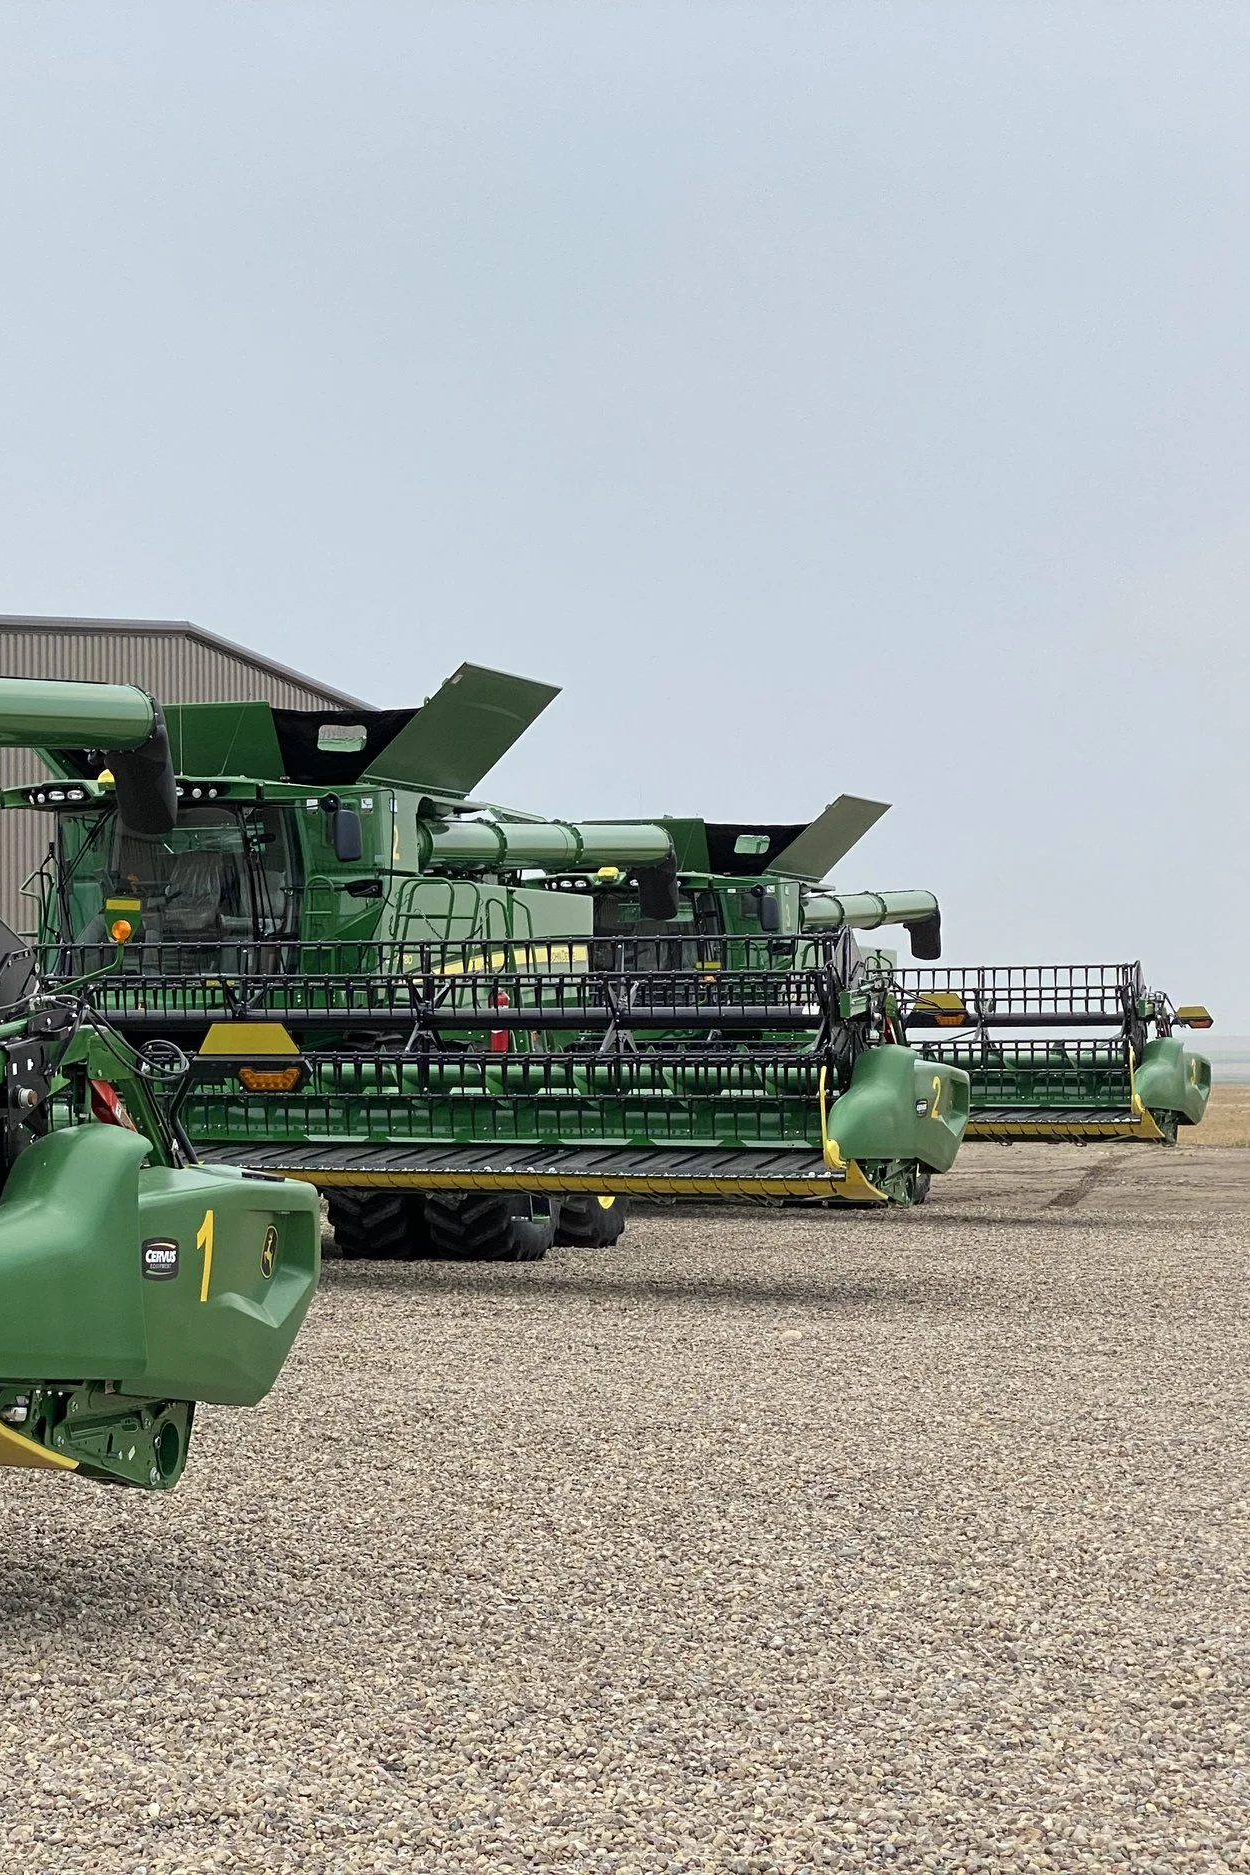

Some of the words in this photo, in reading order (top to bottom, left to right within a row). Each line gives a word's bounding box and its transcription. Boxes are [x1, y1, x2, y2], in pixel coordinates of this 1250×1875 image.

[931, 1075, 941, 1119] 2
[145, 1249, 177, 1264] CERVUS
[196, 1209, 214, 1302] 1
